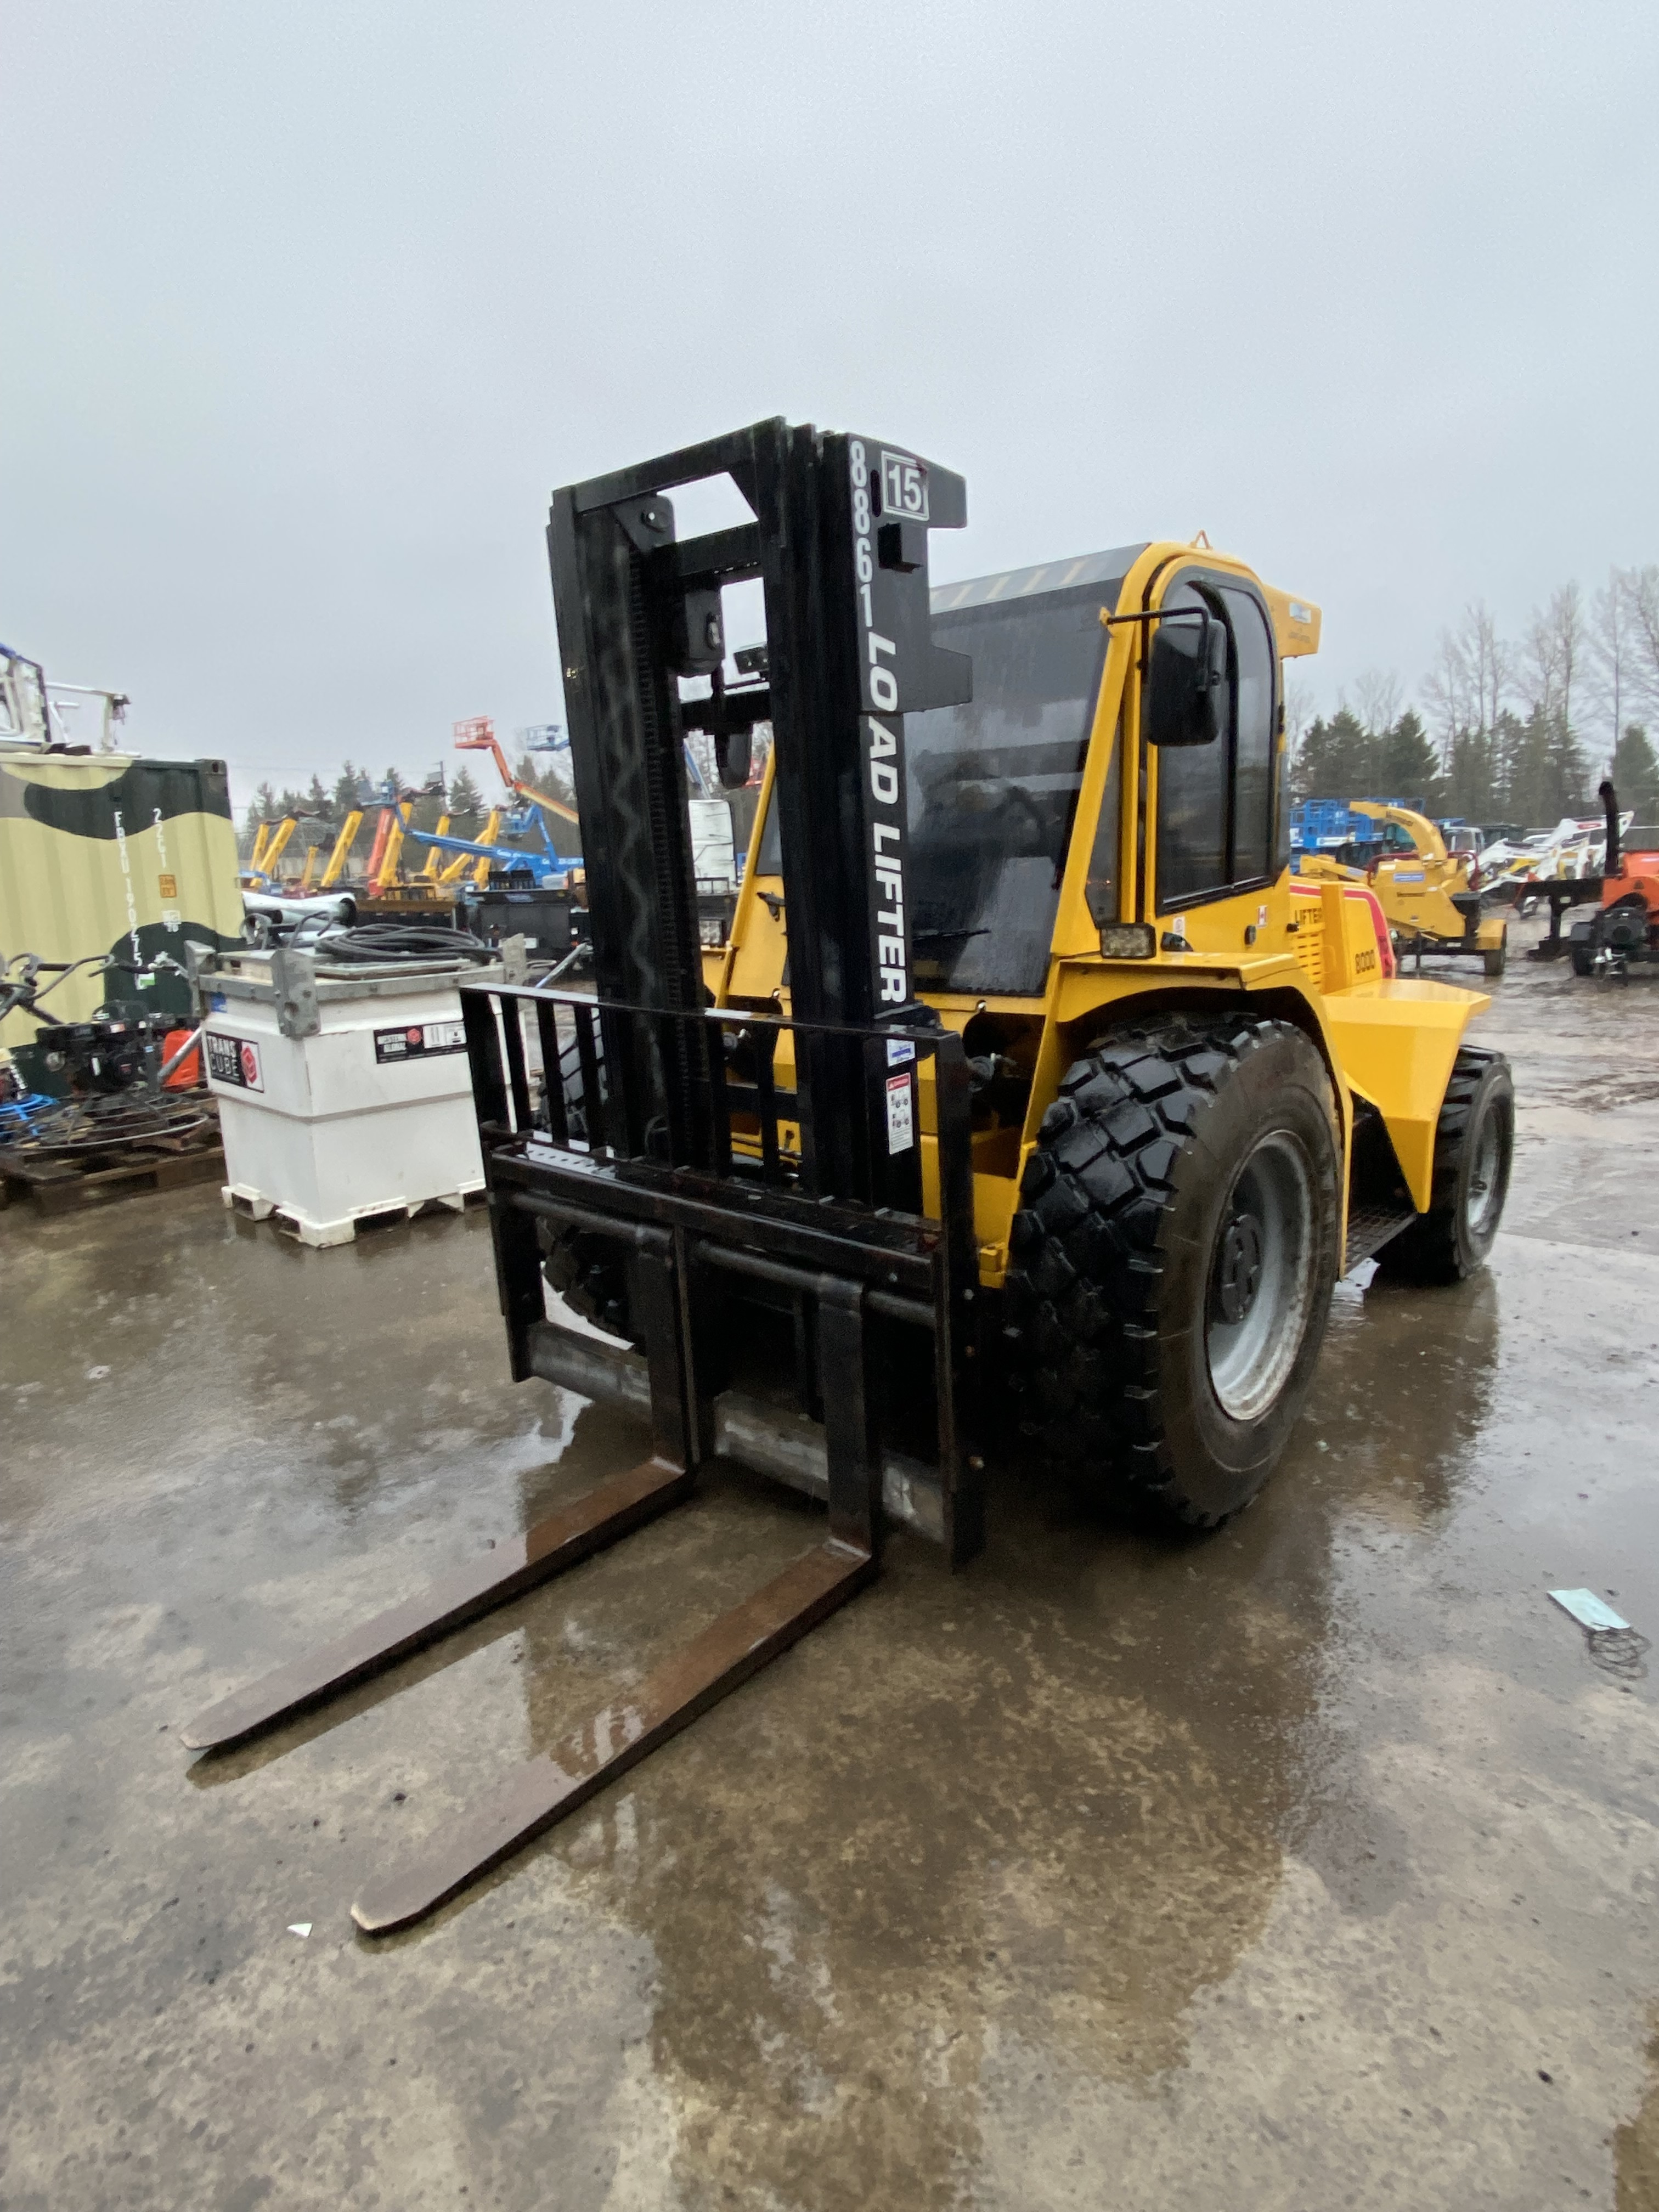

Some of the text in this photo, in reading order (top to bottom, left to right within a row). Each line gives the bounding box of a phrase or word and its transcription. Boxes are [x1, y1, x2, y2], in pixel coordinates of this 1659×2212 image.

[888, 464, 922, 512] 15
[849, 441, 873, 628] 8861
[868, 631, 907, 1003] LOAD LIFTER
[206, 1035, 236, 1058] TRANS
[210, 1054, 240, 1076] CUBE
